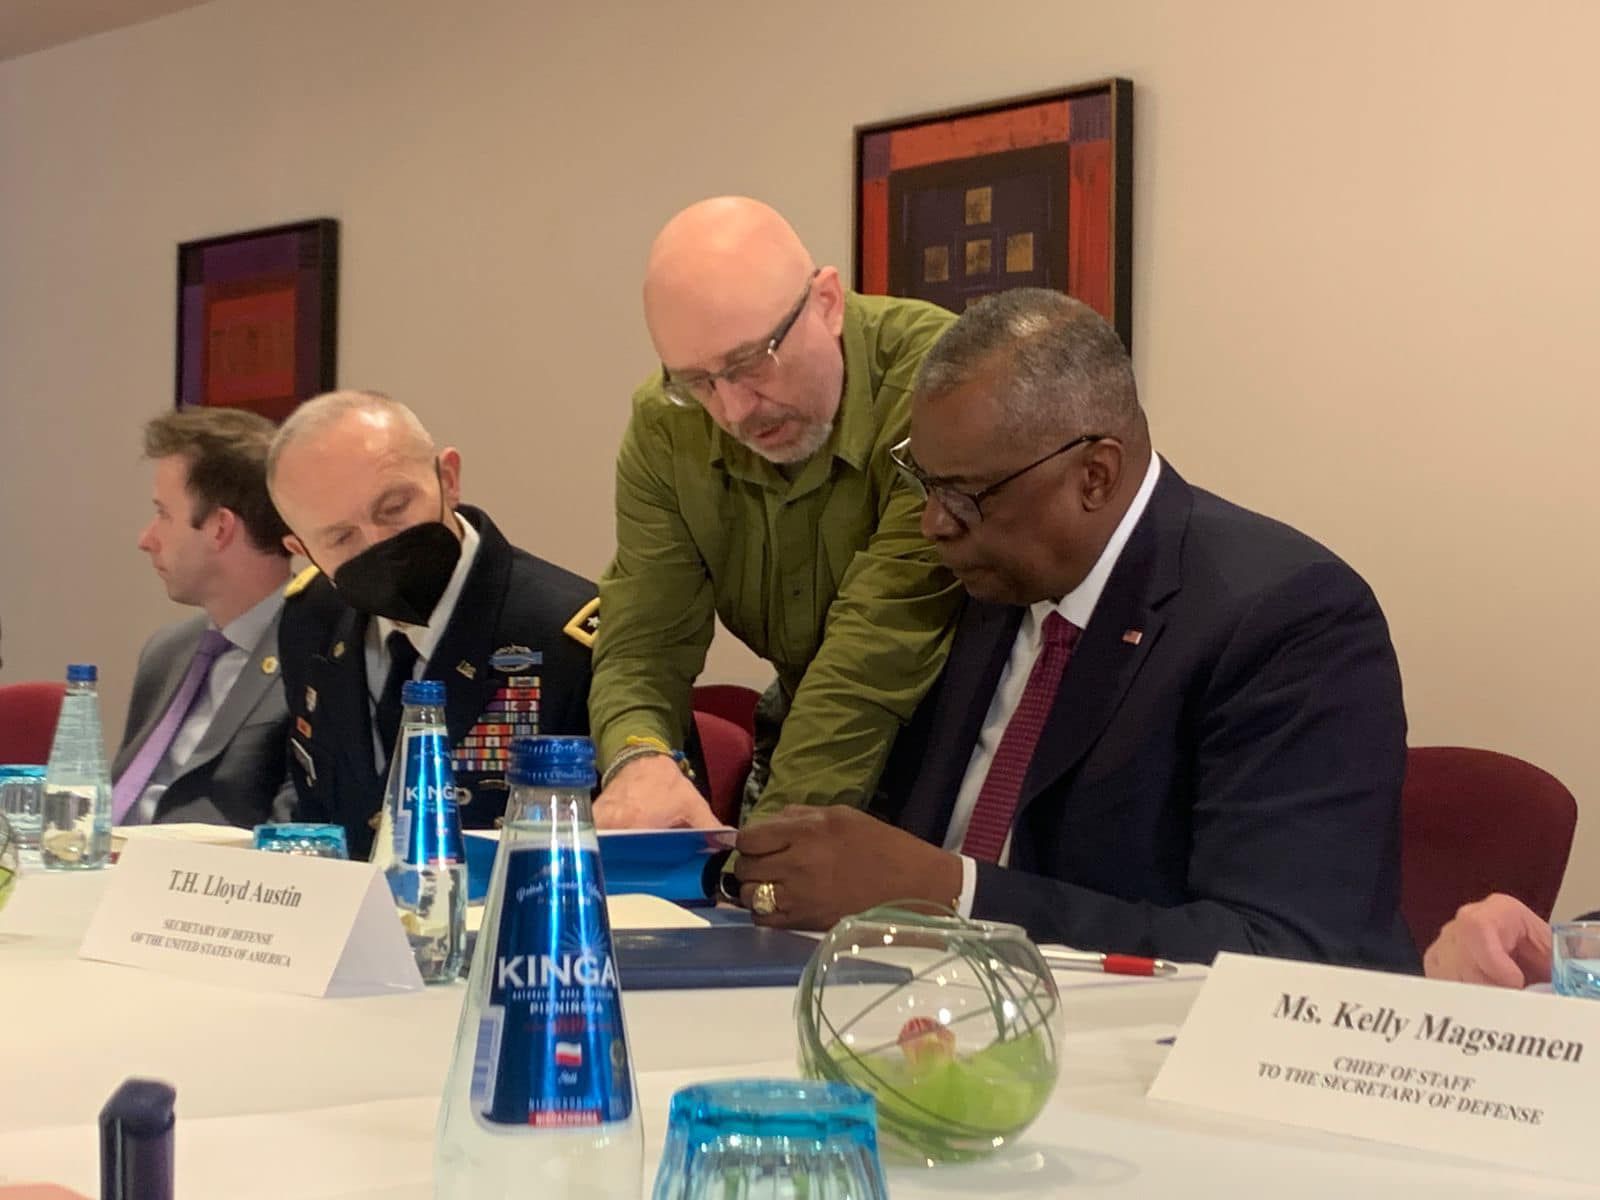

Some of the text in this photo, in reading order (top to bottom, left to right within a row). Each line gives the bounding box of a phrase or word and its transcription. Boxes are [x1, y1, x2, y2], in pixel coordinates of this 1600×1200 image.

[168, 869, 302, 908] T.H. Lloyd Austin
[130, 931, 292, 968] OF THE UNITED STATES OF AMERICA
[163, 919, 274, 946] SECRETARY OF DEFENSE
[498, 953, 617, 989] KINGA
[1273, 992, 1584, 1063] Ms. Kelly Magsamen
[1333, 1056, 1476, 1092] CHIEF OF STAFF
[1258, 1061, 1544, 1125] TO THE SECRETARY OF DEFENSE
